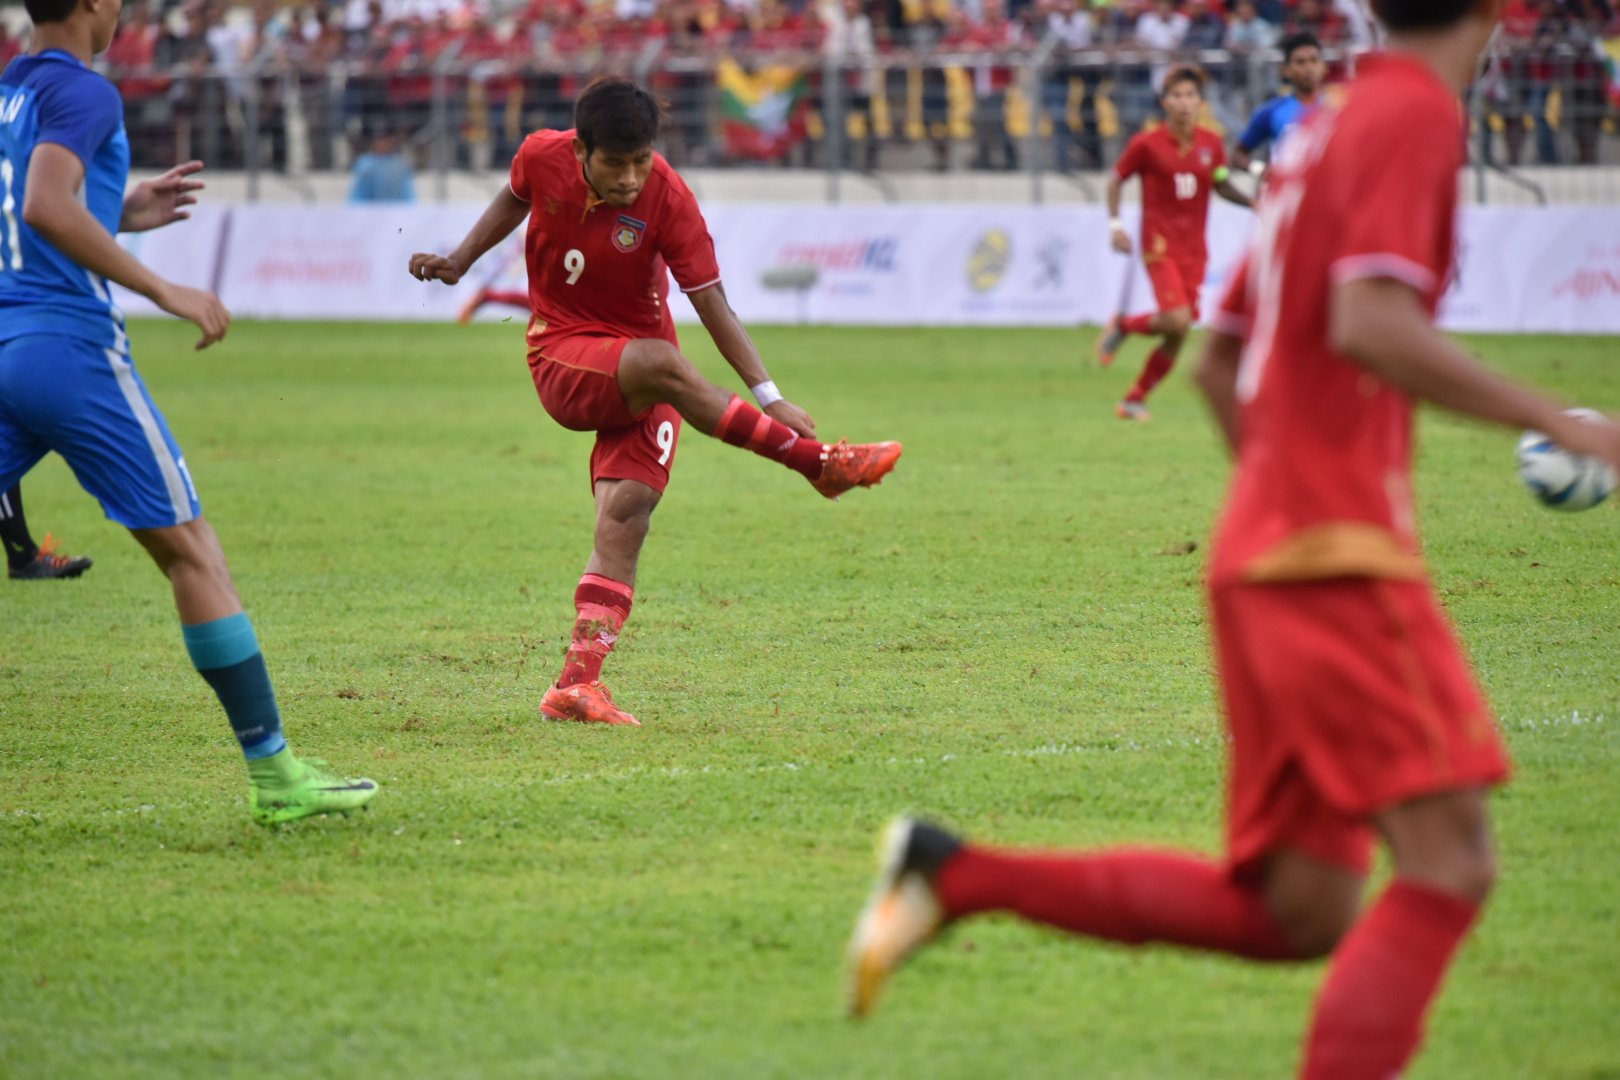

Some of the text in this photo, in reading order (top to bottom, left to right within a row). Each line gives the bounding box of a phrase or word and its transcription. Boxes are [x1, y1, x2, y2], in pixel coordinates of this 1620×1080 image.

[1173, 171, 1198, 200] 10
[563, 248, 585, 286] 9
[656, 420, 674, 466] 9
